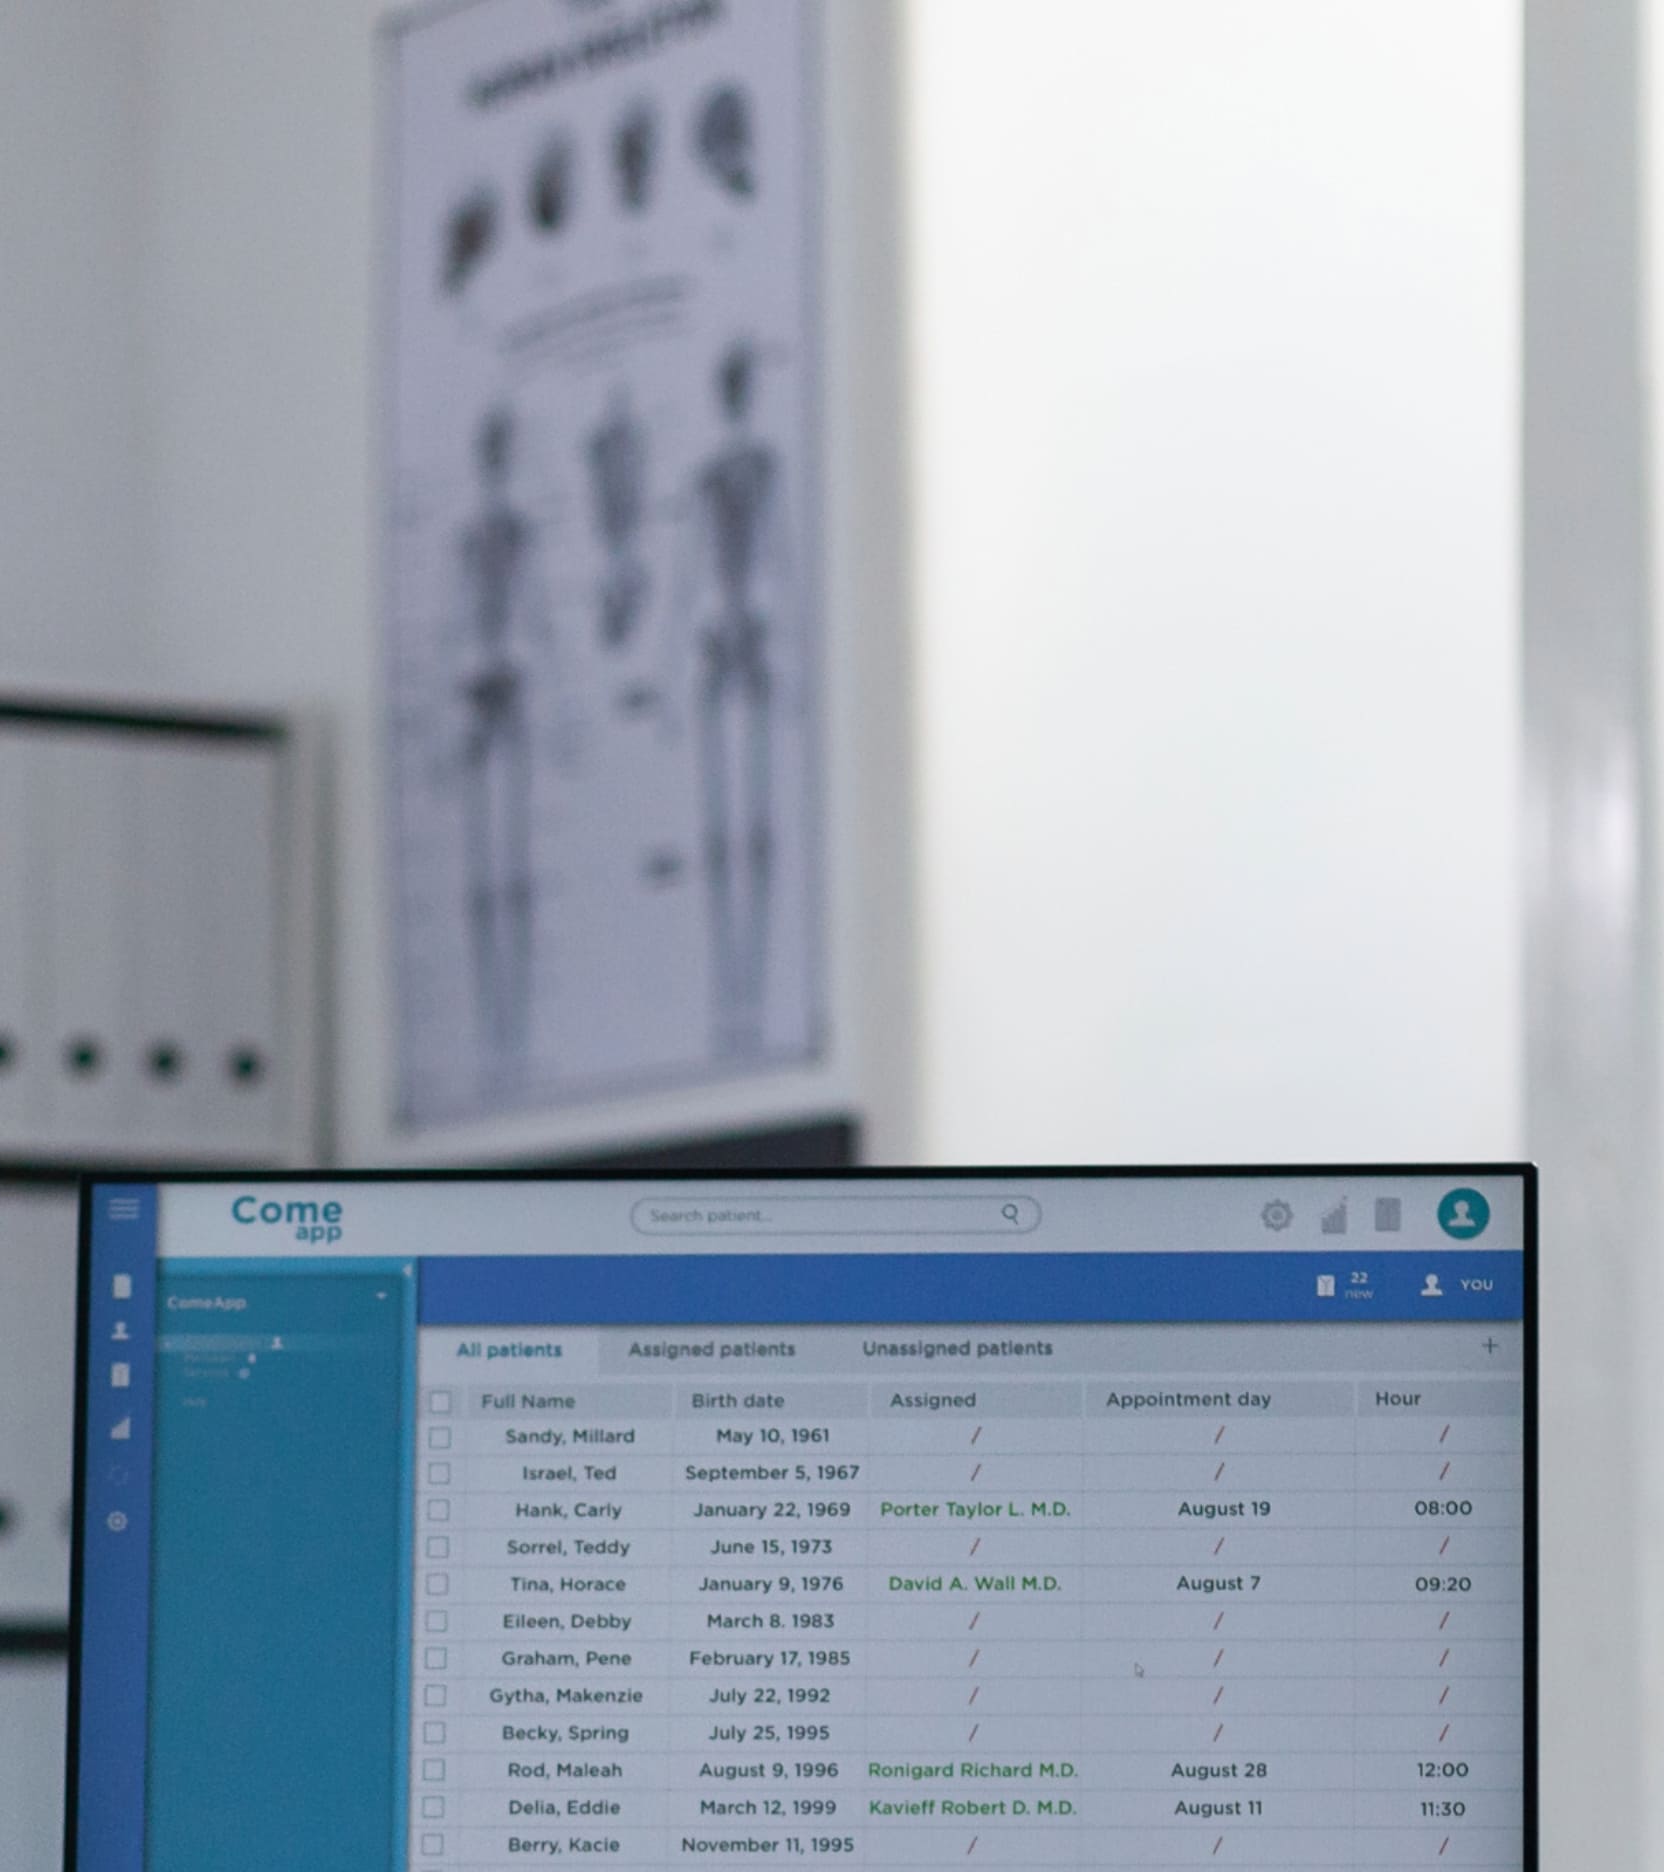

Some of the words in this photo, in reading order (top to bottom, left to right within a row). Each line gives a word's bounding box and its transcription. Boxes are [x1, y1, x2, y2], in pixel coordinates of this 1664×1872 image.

[231, 1195, 343, 1225] Come
[650, 1208, 703, 1224] Search
[296, 1224, 342, 1245] app
[1350, 1271, 1369, 1284] 22
[1460, 1278, 1494, 1291] YOU
[167, 1295, 247, 1311] ComeApp
[456, 1342, 482, 1358] All
[486, 1343, 563, 1360] patients
[628, 1341, 715, 1361] Assigned
[719, 1341, 796, 1359] patients
[862, 1340, 971, 1360] Unassigned
[976, 1340, 1054, 1359] patients
[481, 1393, 516, 1410] Full
[520, 1393, 576, 1409] Name
[691, 1392, 738, 1409] Birth
[743, 1393, 785, 1409] date
[889, 1392, 977, 1411] Assigned
[1106, 1391, 1232, 1410] Appointment
[1237, 1391, 1272, 1410] day
[1375, 1391, 1422, 1407] Hour
[505, 1428, 567, 1447] Sandy,
[572, 1428, 636, 1444] Millard
[716, 1428, 754, 1447] May
[759, 1427, 785, 1445] 10,
[791, 1427, 830, 1444] 1961
[522, 1465, 577, 1483] Israel,
[583, 1465, 617, 1481] Ted
[685, 1464, 789, 1483] September
[794, 1464, 811, 1482] 5,
[817, 1464, 861, 1481] 1967
[515, 1502, 568, 1520] Hank,
[573, 1502, 622, 1521] Carly
[693, 1502, 768, 1521] January
[773, 1501, 801, 1519] 22,
[807, 1501, 851, 1518] 1969
[880, 1501, 939, 1518] Porter
[945, 1501, 1006, 1520] Taylor
[1009, 1501, 1026, 1518] L.
[1030, 1501, 1072, 1518] M.D.
[1177, 1501, 1245, 1520] August
[1251, 1500, 1272, 1517] 19
[1414, 1499, 1473, 1516] 08:00
[506, 1539, 568, 1557] Sorrel,
[573, 1539, 631, 1558] Teddy
[710, 1539, 755, 1555] June
[761, 1538, 785, 1556] 15,
[791, 1538, 833, 1555] 1973
[510, 1576, 554, 1594] Tina,
[559, 1577, 627, 1592] Horace
[698, 1577, 773, 1595] January
[778, 1576, 796, 1594] 9,
[801, 1575, 844, 1592] 1976
[888, 1575, 943, 1592] David
[948, 1575, 969, 1592] A.
[973, 1575, 1016, 1592] Wall
[1021, 1575, 1062, 1592] M.D.
[1176, 1575, 1244, 1594] August
[1250, 1574, 1261, 1591] 7
[1415, 1576, 1472, 1593] 09:20
[502, 1613, 565, 1631] Eileen,
[570, 1613, 632, 1632] Debby
[707, 1613, 764, 1629] March
[792, 1613, 835, 1629] 1983
[501, 1650, 580, 1668] Graham,
[585, 1650, 632, 1667] Pene
[689, 1650, 775, 1669] February
[780, 1650, 802, 1668] 17,
[807, 1650, 851, 1666] 1985
[489, 1687, 550, 1707] Gytha,
[555, 1688, 643, 1704] Makenzie
[709, 1688, 747, 1706] July
[753, 1687, 781, 1705] 22,
[787, 1687, 831, 1704] 1992
[501, 1724, 563, 1744] Becky,
[568, 1725, 630, 1744] Spring
[708, 1725, 747, 1744] July
[752, 1724, 781, 1742] 25,
[787, 1724, 831, 1741] 1995
[507, 1762, 551, 1780] Rod,
[556, 1762, 623, 1778] Maleah
[698, 1762, 765, 1781] August
[771, 1762, 789, 1779] 9,
[794, 1762, 839, 1778] 1996
[867, 1762, 955, 1781] Ronigard
[960, 1762, 1033, 1779] Richard
[1039, 1762, 1078, 1779] M.D.
[1170, 1762, 1238, 1781] August
[1243, 1762, 1268, 1779] 28
[1417, 1761, 1470, 1778] 12:00
[508, 1799, 561, 1817] Delia,
[566, 1799, 621, 1816] Eddie
[699, 1799, 757, 1816] March
[762, 1799, 786, 1816] 12,
[792, 1799, 837, 1816] 1999
[869, 1799, 936, 1816] Kavieff
[941, 1799, 1006, 1816] Robert
[1012, 1799, 1032, 1816] D.
[1036, 1799, 1077, 1816] M.D.
[1174, 1800, 1242, 1819] August
[1247, 1799, 1263, 1816] 11
[1420, 1801, 1467, 1817] 11:30
[507, 1836, 563, 1856] Berry,
[568, 1837, 621, 1853] Kacie
[681, 1837, 779, 1853] November
[785, 1837, 805, 1855] 11,
[811, 1836, 855, 1853] 1995
